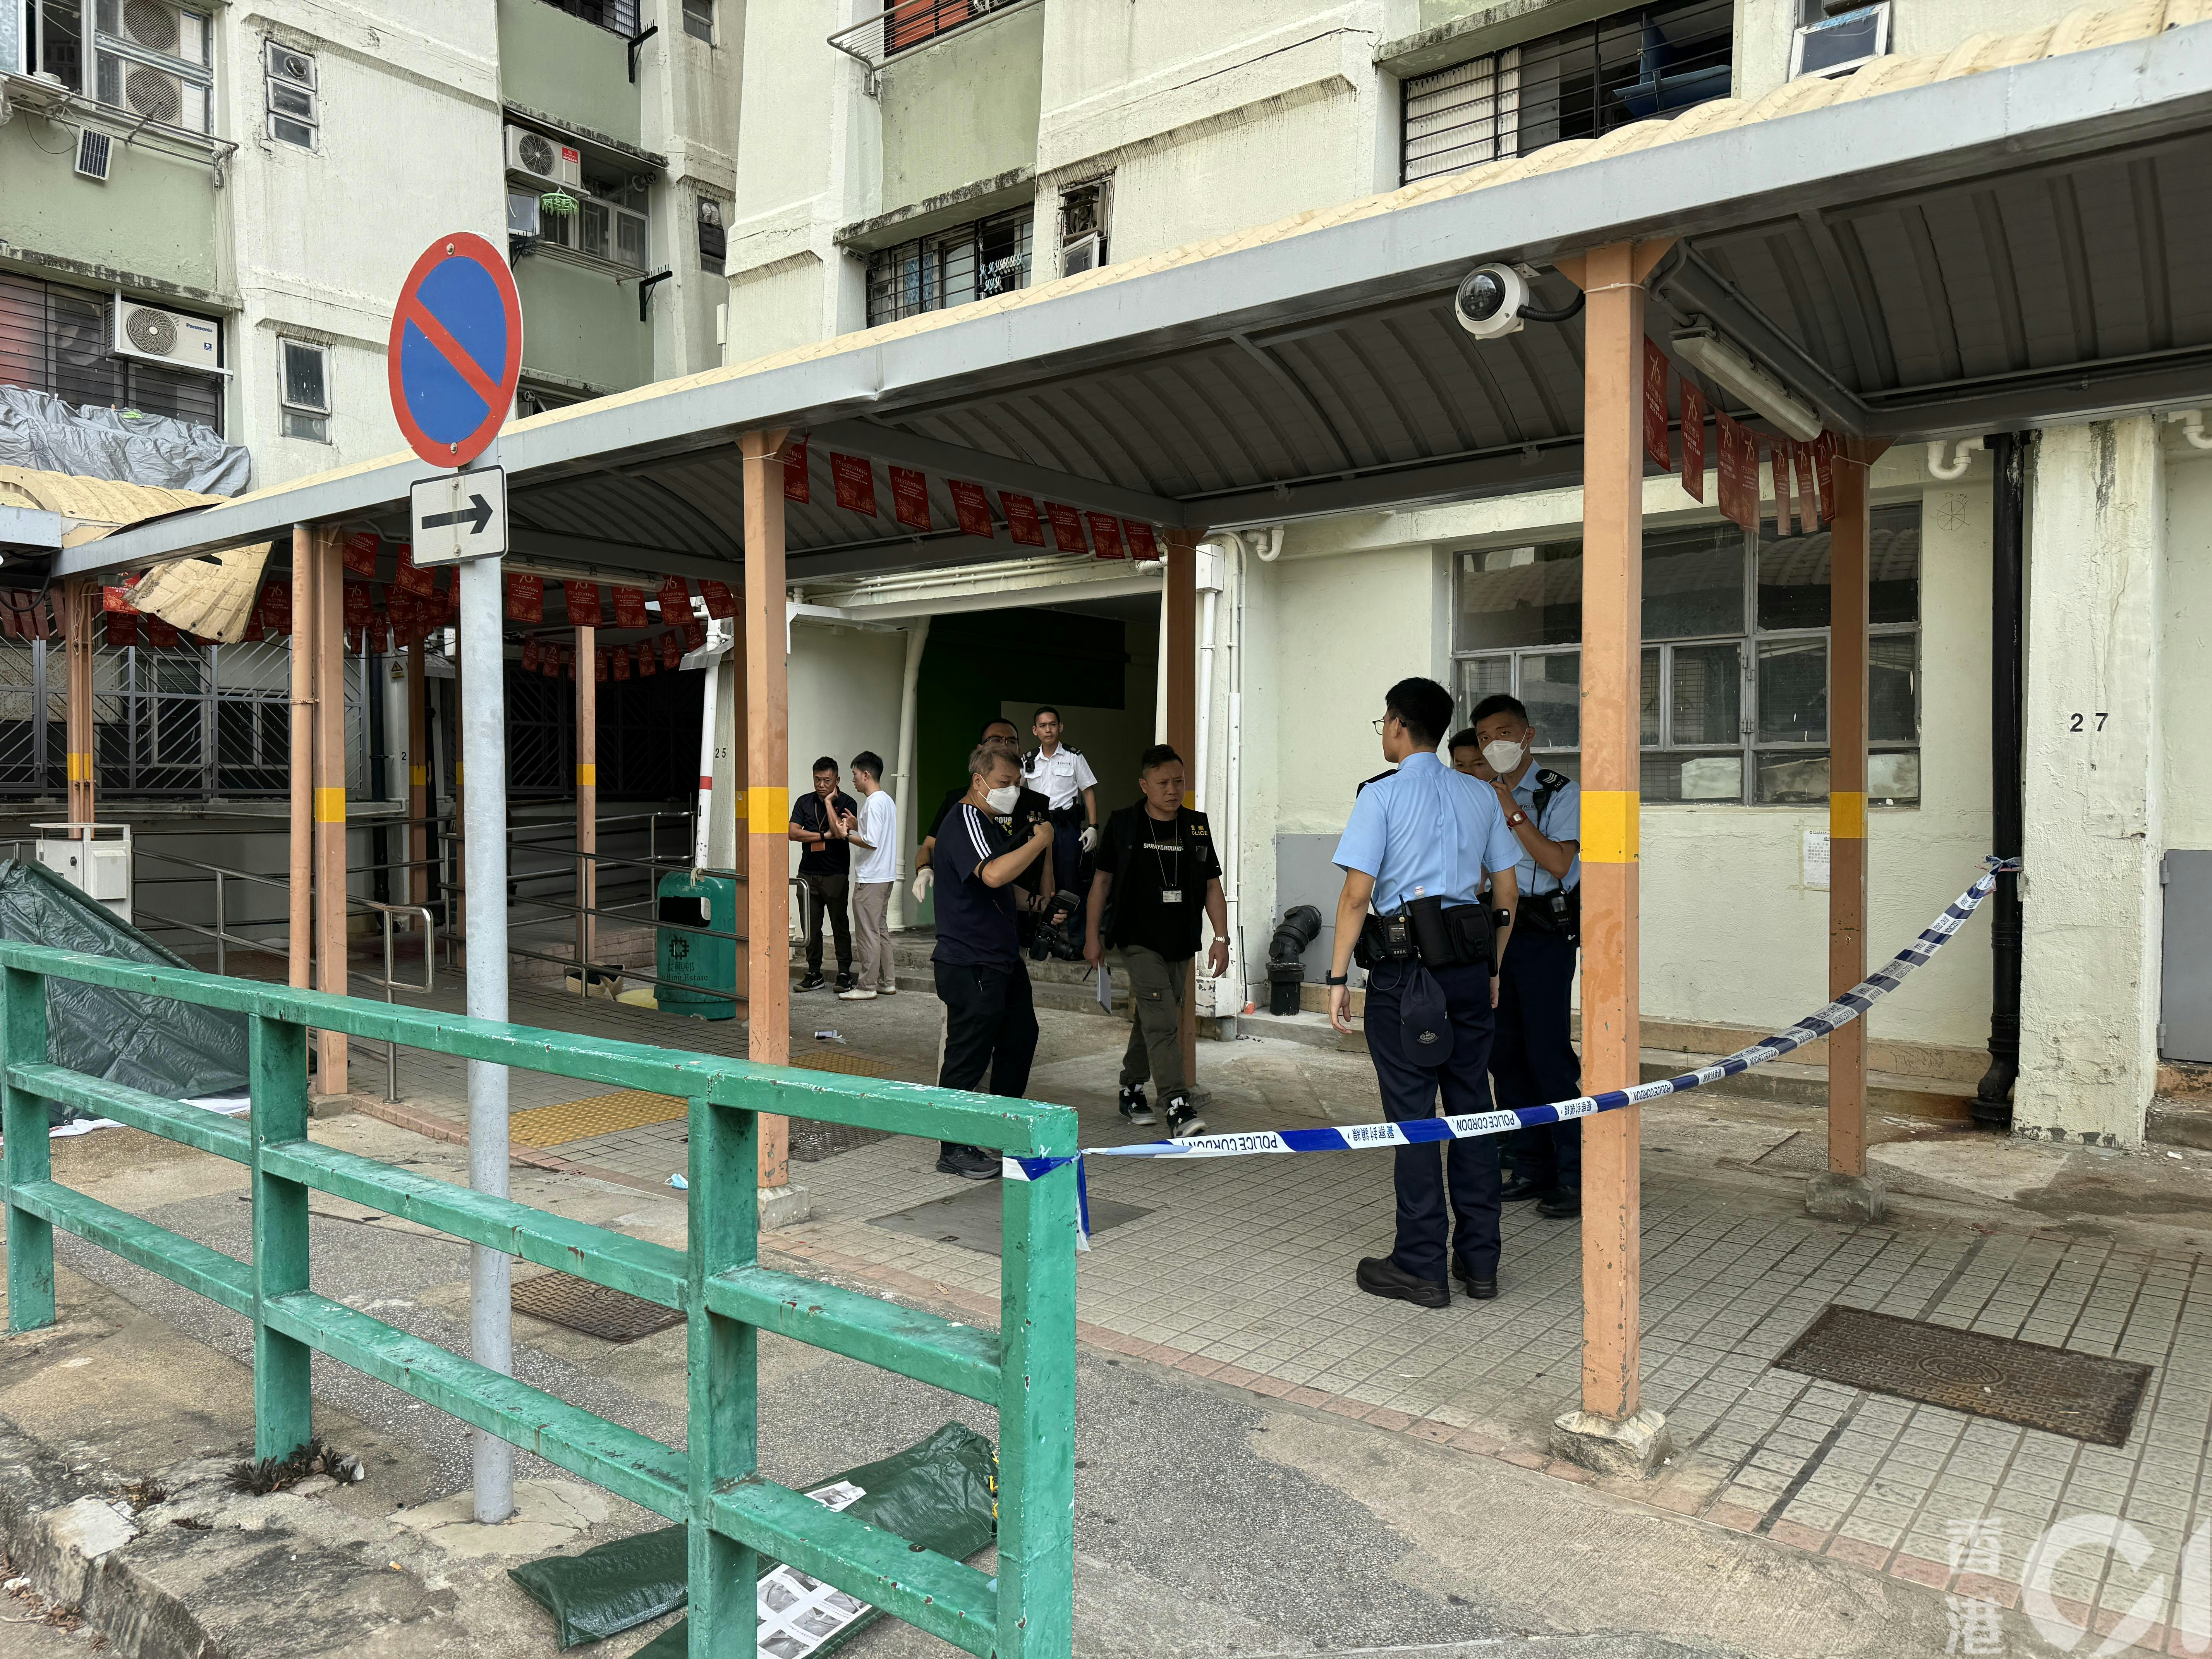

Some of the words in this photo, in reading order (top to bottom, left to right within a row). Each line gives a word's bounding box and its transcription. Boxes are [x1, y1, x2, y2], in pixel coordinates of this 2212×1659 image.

[186, 323, 213, 333] Panasonic
[268, 584, 283, 598] 76
[348, 584, 362, 598] 76
[1488, 1113, 1515, 1128] POLICE
[1238, 1135, 1278, 1151] POLICE
